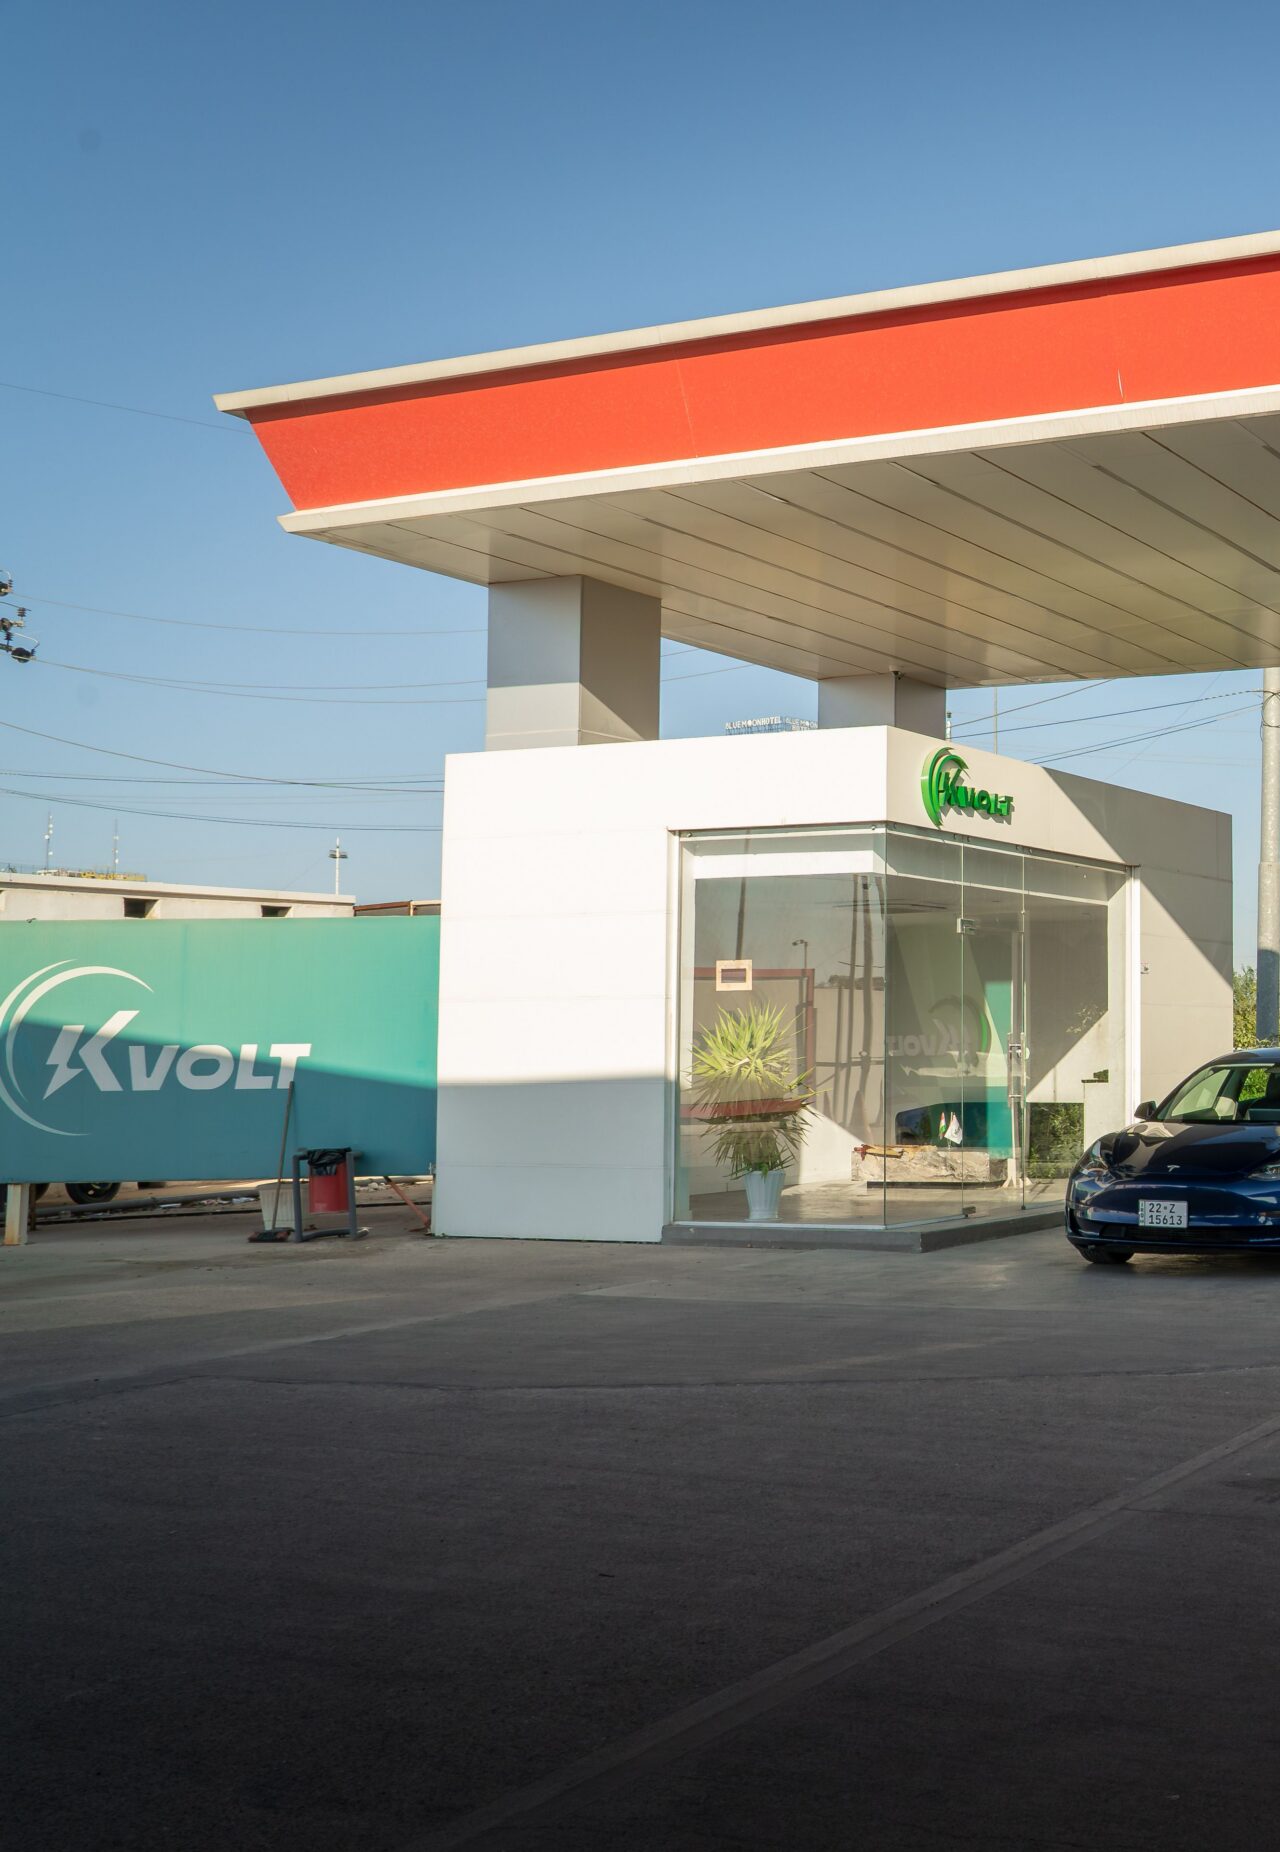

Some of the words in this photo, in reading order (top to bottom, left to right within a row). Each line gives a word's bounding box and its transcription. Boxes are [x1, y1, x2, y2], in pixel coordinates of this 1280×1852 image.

[938, 768, 1014, 817] KVOLT
[43, 1010, 312, 1100] KVOLT
[1149, 1203, 1162, 1213] 22
[1169, 1203, 1176, 1214] Z
[1149, 1214, 1183, 1226] 15613
